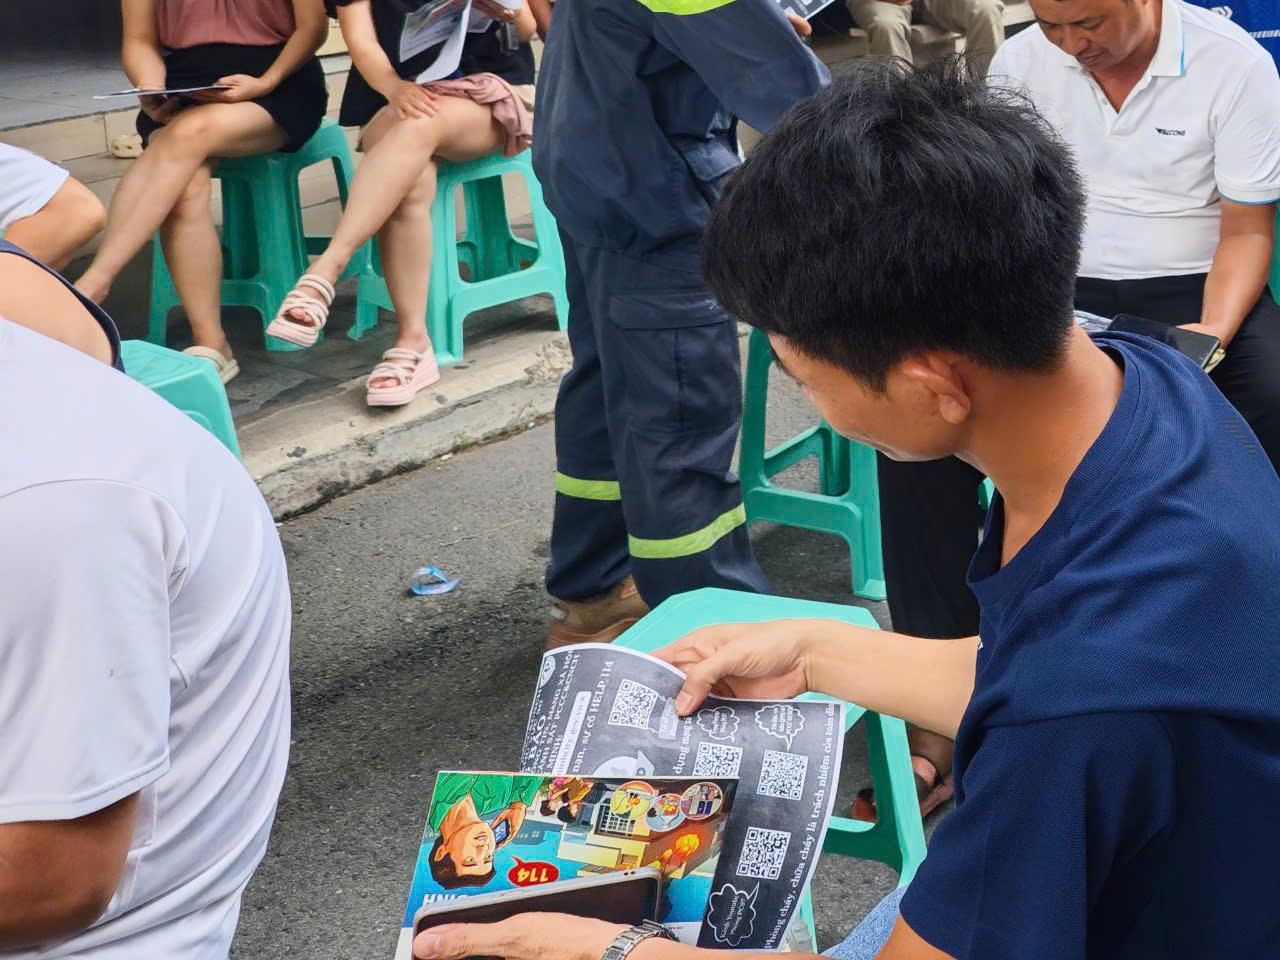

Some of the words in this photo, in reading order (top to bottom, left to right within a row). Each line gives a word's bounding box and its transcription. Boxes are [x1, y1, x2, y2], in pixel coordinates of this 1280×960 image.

[601, 659, 614, 678] 114
[589, 679, 607, 713] HELP
[584, 714, 595, 728] cố
[825, 719, 834, 738] toàn
[528, 715, 546, 761] BÁO
[580, 730, 592, 745] sự
[822, 739, 832, 755] của
[572, 746, 587, 773] nạn,
[673, 748, 690, 775] dụng
[818, 757, 831, 788] nhiệm
[811, 792, 824, 823] trách
[806, 825, 817, 839] là
[799, 838, 812, 864] cháy
[518, 869, 549, 883] 114
[790, 862, 805, 887] chữa
[779, 886, 797, 919] cháy,
[764, 918, 786, 949] Phòng
